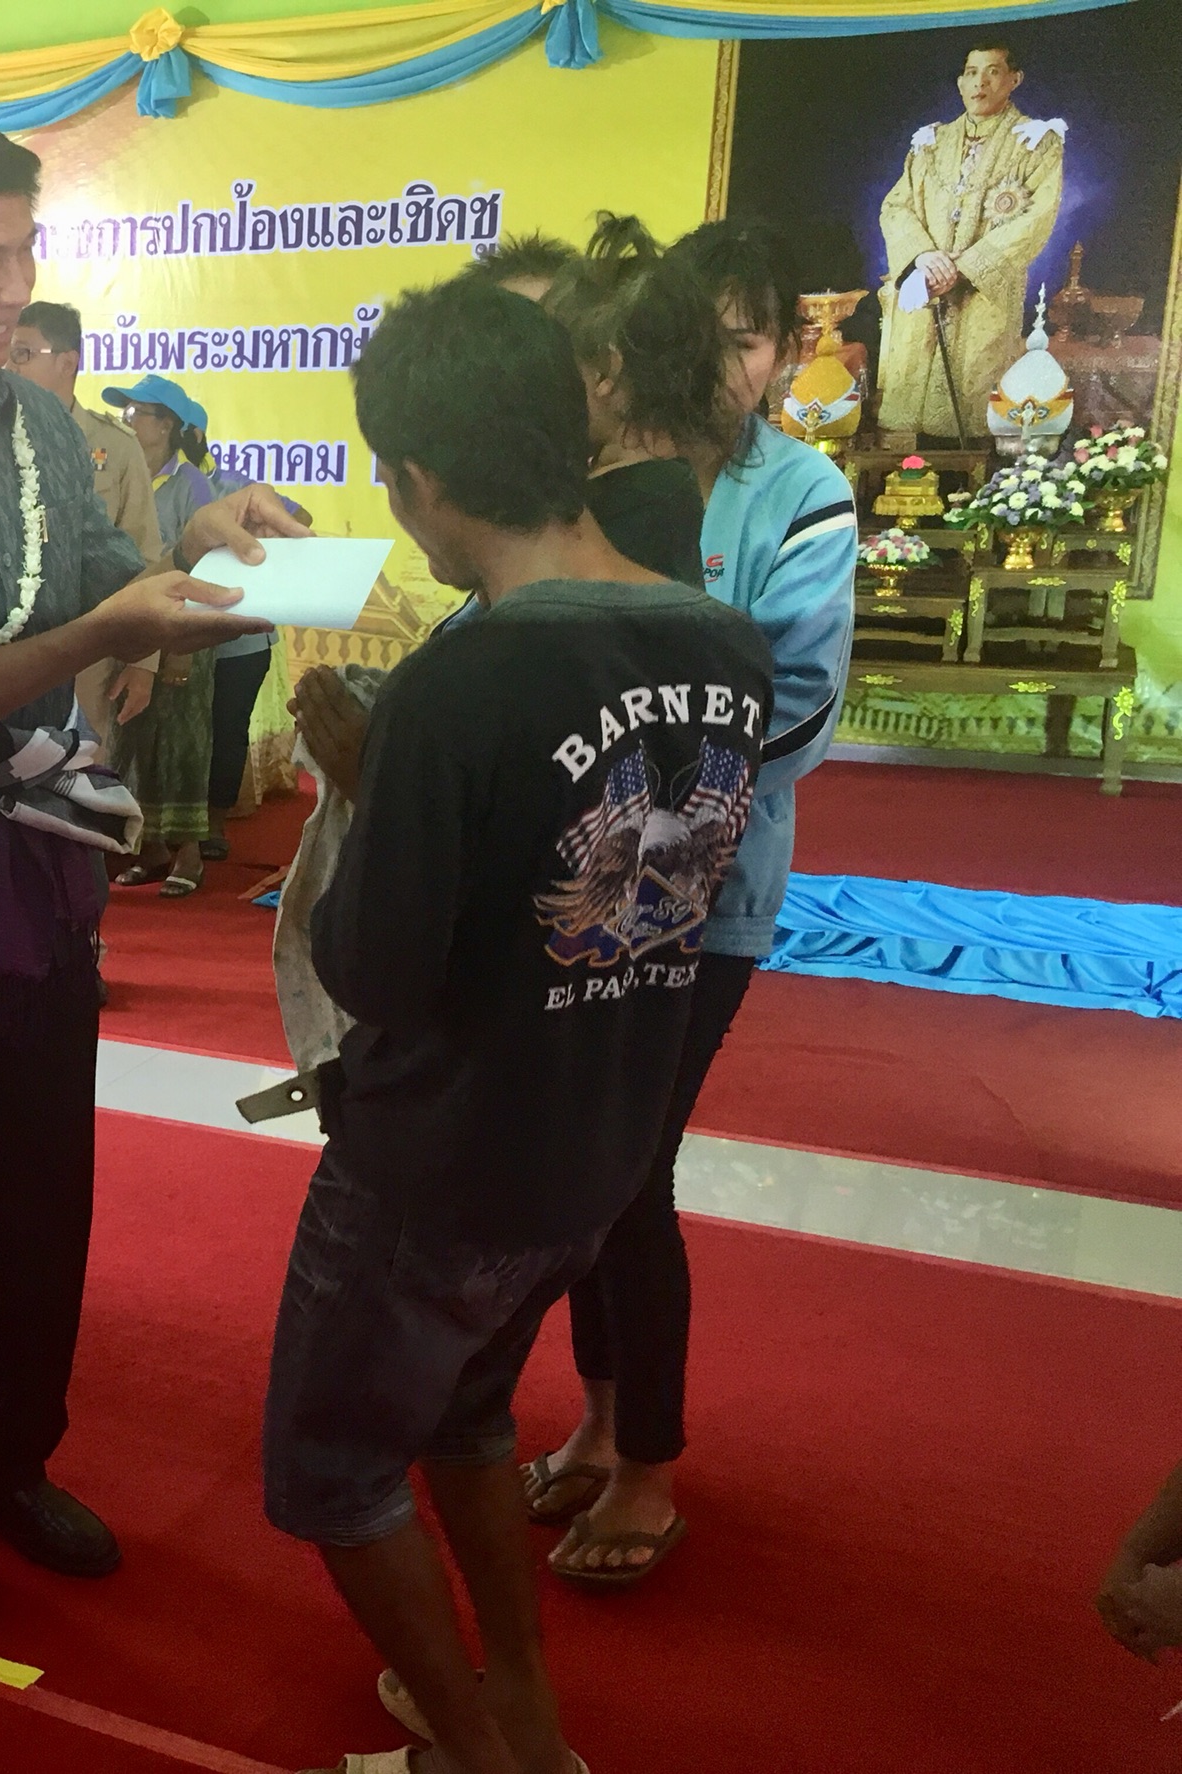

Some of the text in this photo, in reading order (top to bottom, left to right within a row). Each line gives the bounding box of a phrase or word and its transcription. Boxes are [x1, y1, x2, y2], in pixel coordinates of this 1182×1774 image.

[78, 307, 379, 372] าบันพระมหากษั
[552, 684, 763, 784] BARNET
